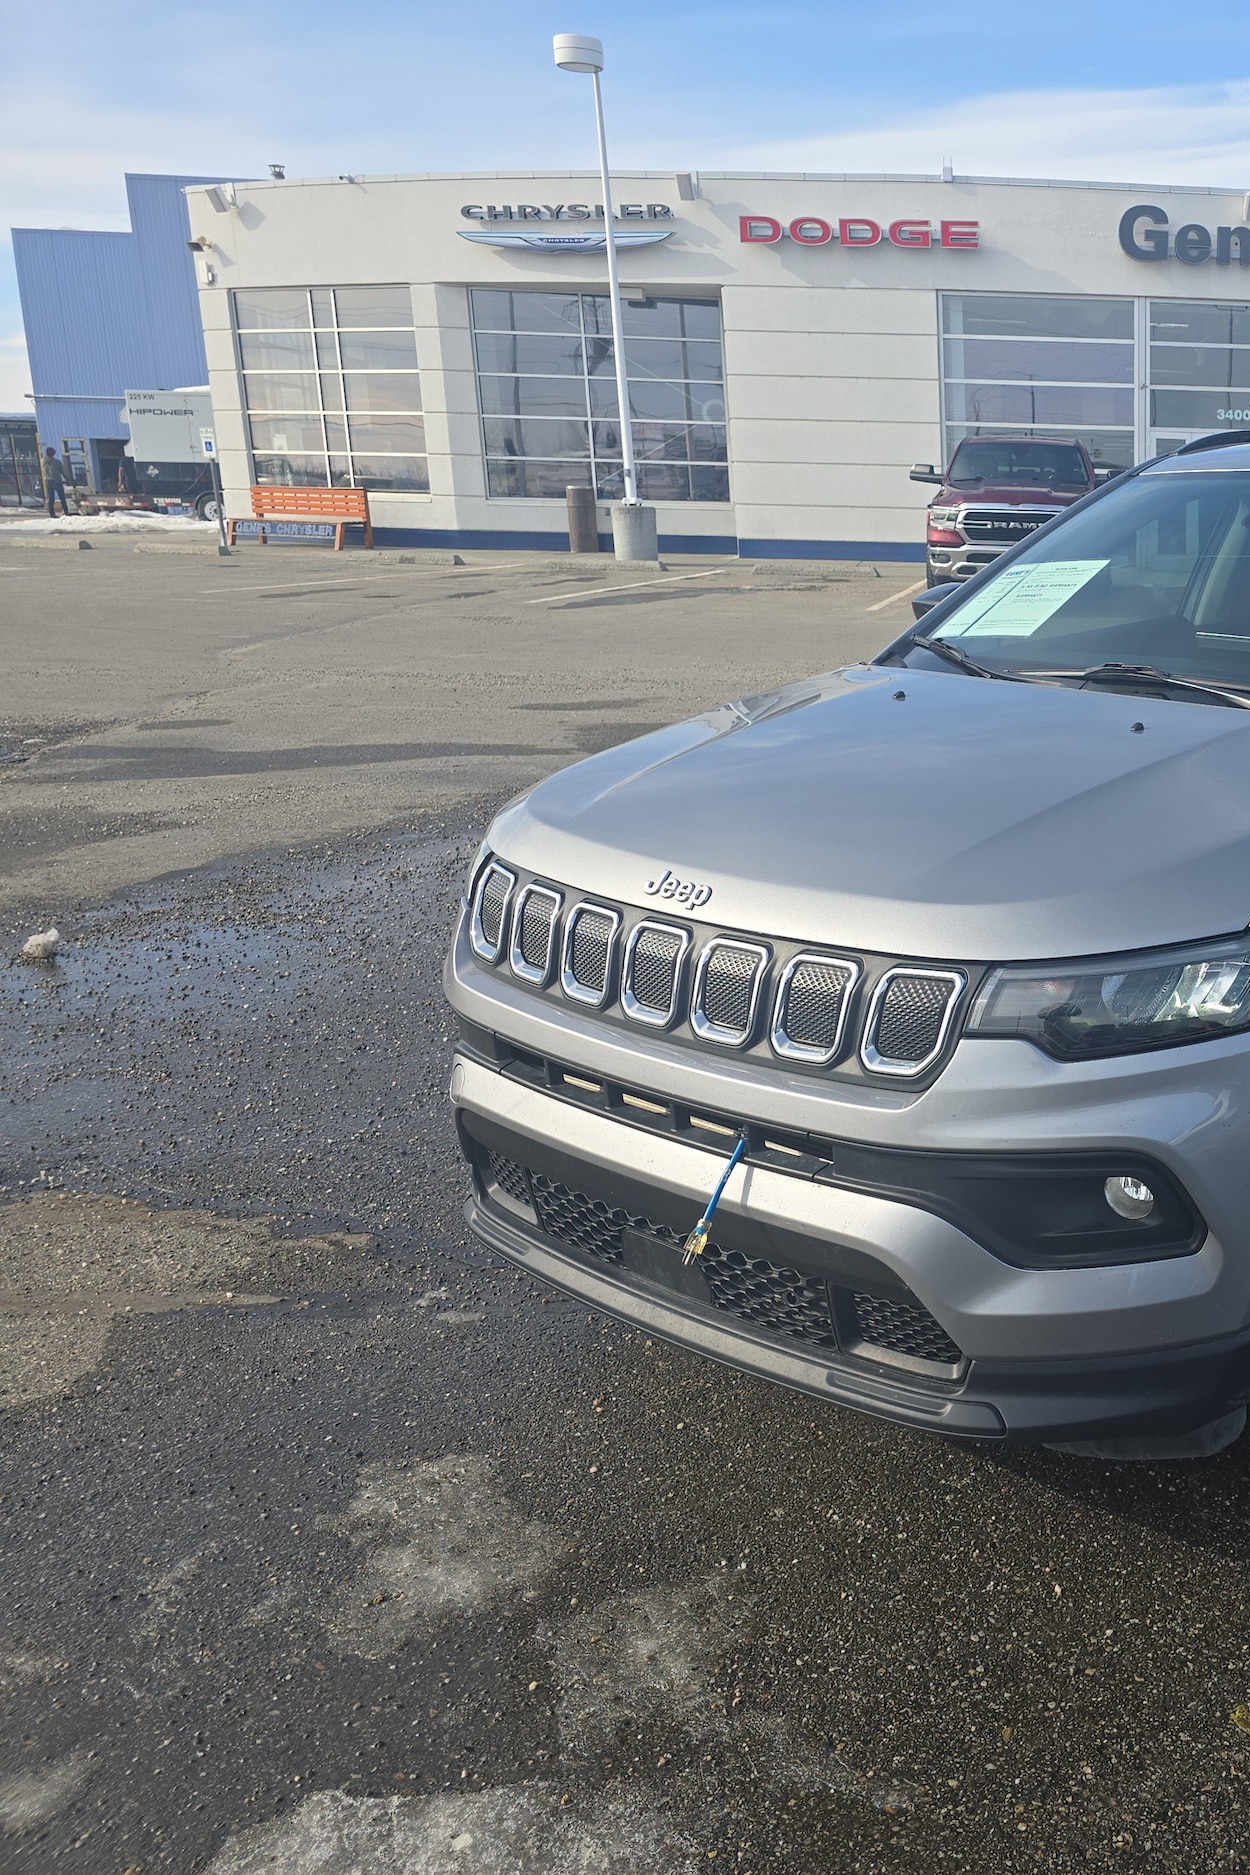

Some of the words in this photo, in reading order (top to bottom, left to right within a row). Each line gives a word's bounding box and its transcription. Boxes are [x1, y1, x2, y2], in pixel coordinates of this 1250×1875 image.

[460, 203, 674, 219] CHRYSLER
[739, 216, 980, 249] DODGE
[129, 408, 194, 416] HIPOWER
[643, 870, 713, 911] Jeep
